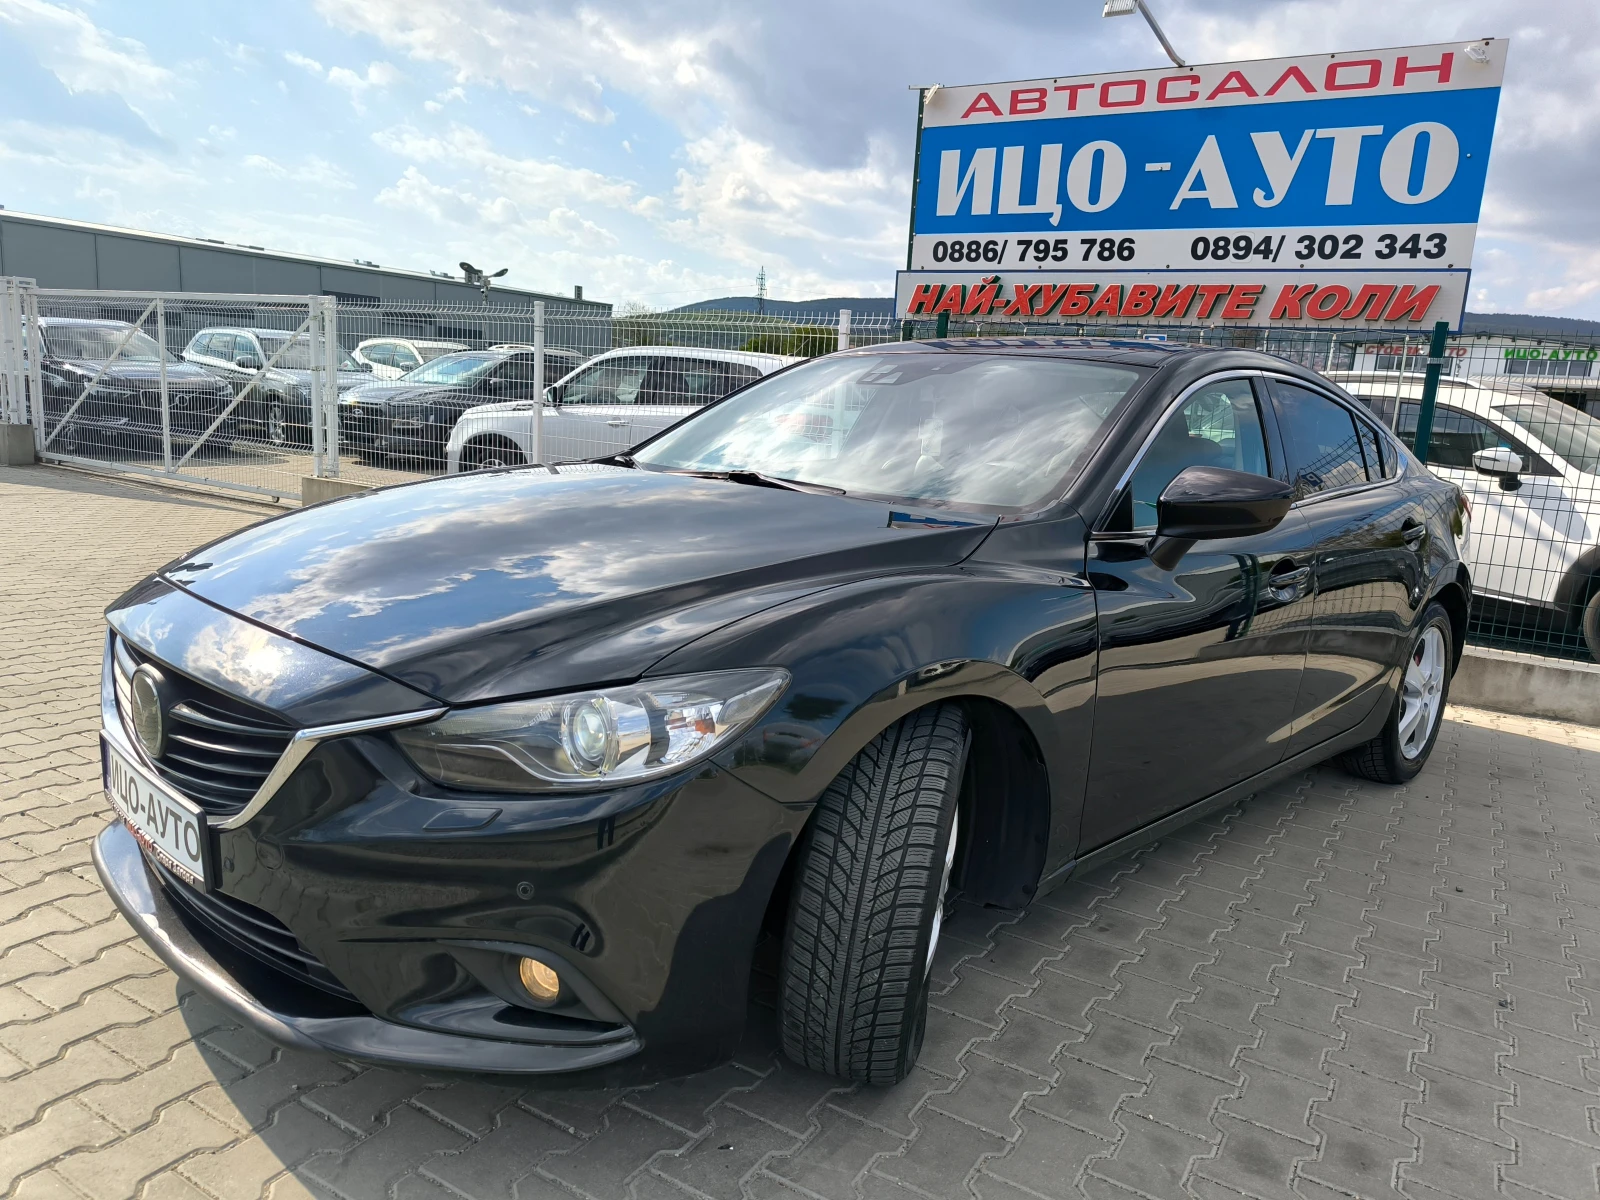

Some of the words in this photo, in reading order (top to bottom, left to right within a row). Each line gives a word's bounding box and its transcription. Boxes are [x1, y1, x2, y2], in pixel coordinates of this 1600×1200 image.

[962, 51, 1455, 119] АВТОСАЛОН
[932, 239, 1008, 265] 0886/
[1016, 238, 1068, 262] 795
[1080, 237, 1136, 262] 786
[1190, 235, 1285, 263] 0894/
[1294, 234, 1363, 260] 302
[1375, 232, 1447, 260] 343
[907, 276, 1265, 320] НАЙ-ХУБАВИТЕ
[1269, 283, 1441, 322] КОЛИ
[1504, 348, 1599, 362] ИЦО-АУТО
[110, 754, 201, 863] ИЦО-АУТО
